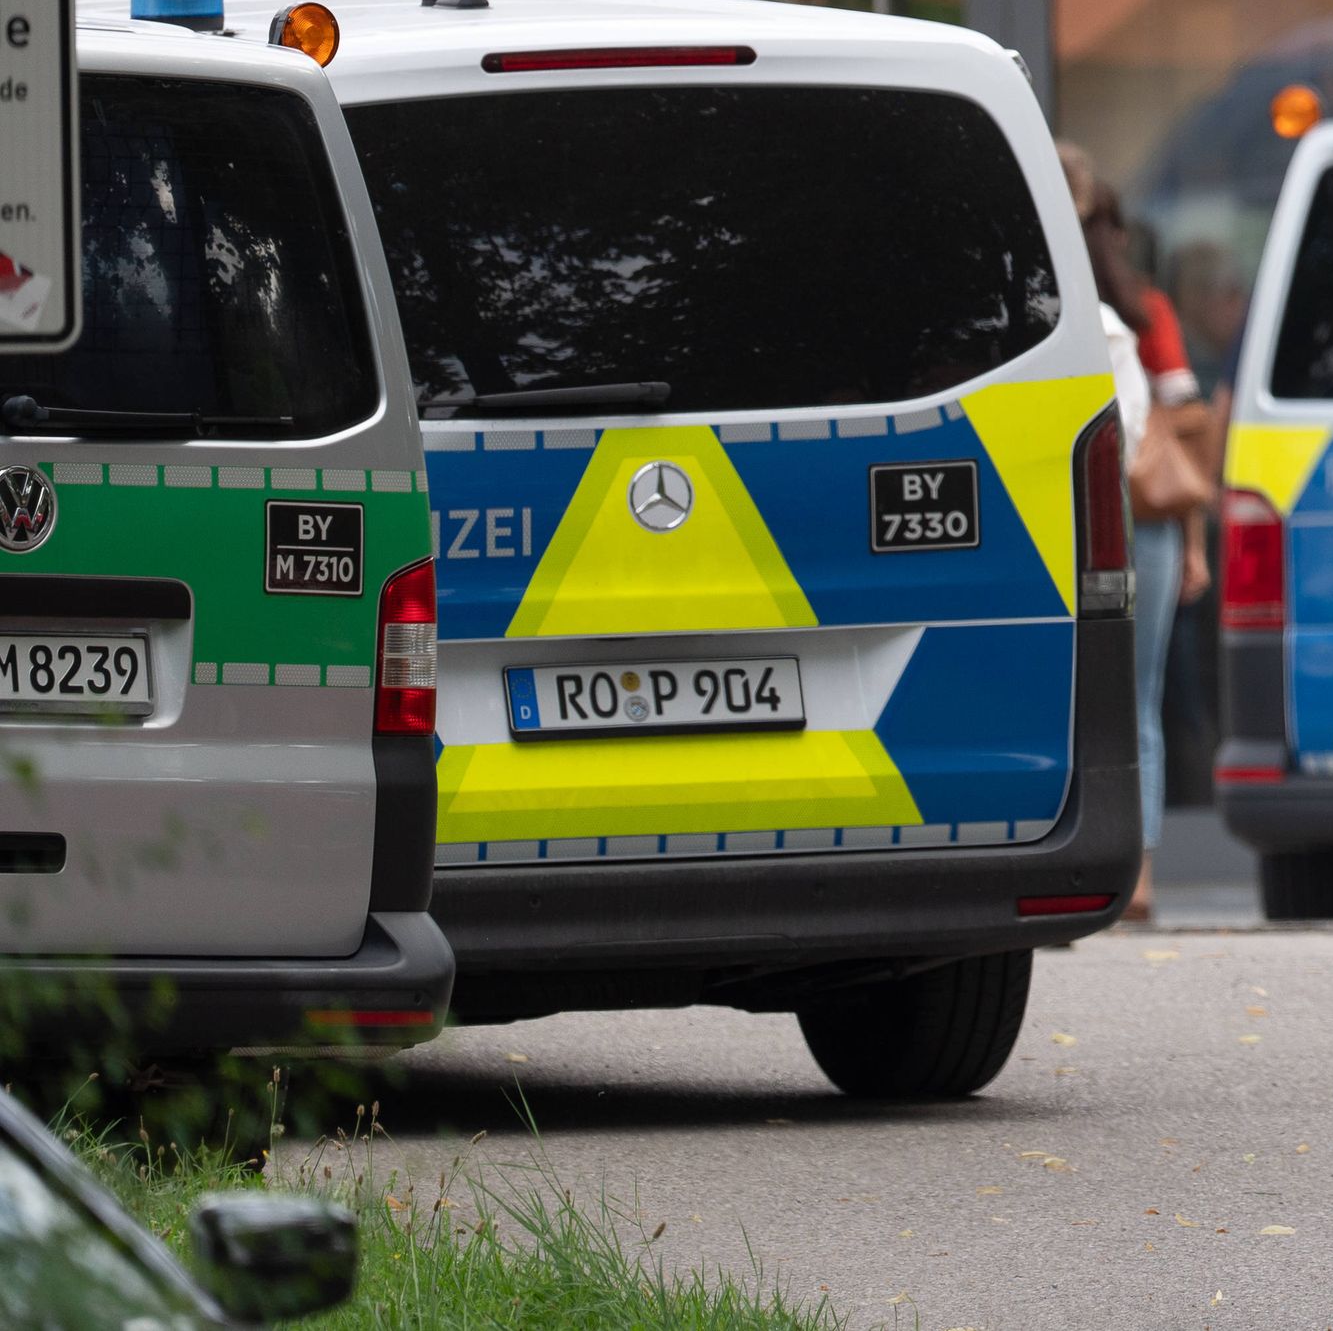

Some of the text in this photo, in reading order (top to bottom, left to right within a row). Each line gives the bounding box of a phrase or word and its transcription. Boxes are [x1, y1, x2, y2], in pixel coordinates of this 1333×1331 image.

[902, 471, 945, 501] BY
[297, 514, 334, 541] BY
[431, 507, 533, 560] IZEI
[881, 510, 969, 542] 7330
[275, 554, 355, 584] M 7310
[555, 666, 781, 721] RO P 904
